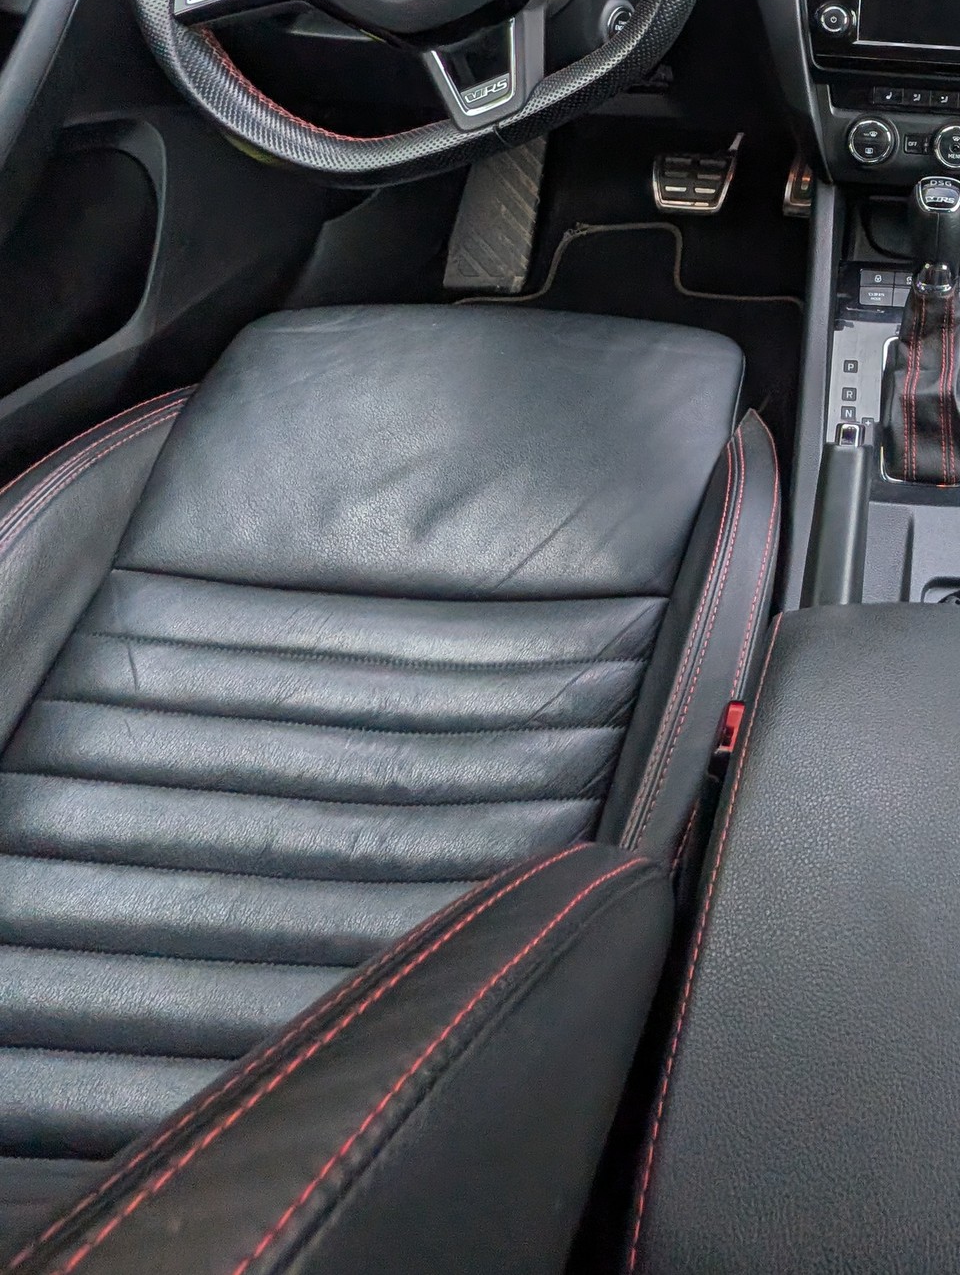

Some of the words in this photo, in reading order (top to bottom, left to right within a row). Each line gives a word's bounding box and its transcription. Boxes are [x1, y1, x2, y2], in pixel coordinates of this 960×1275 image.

[930, 179, 952, 187] DSG
[847, 363, 855, 372] P
[846, 390, 853, 399] R
[845, 409, 852, 418] N
